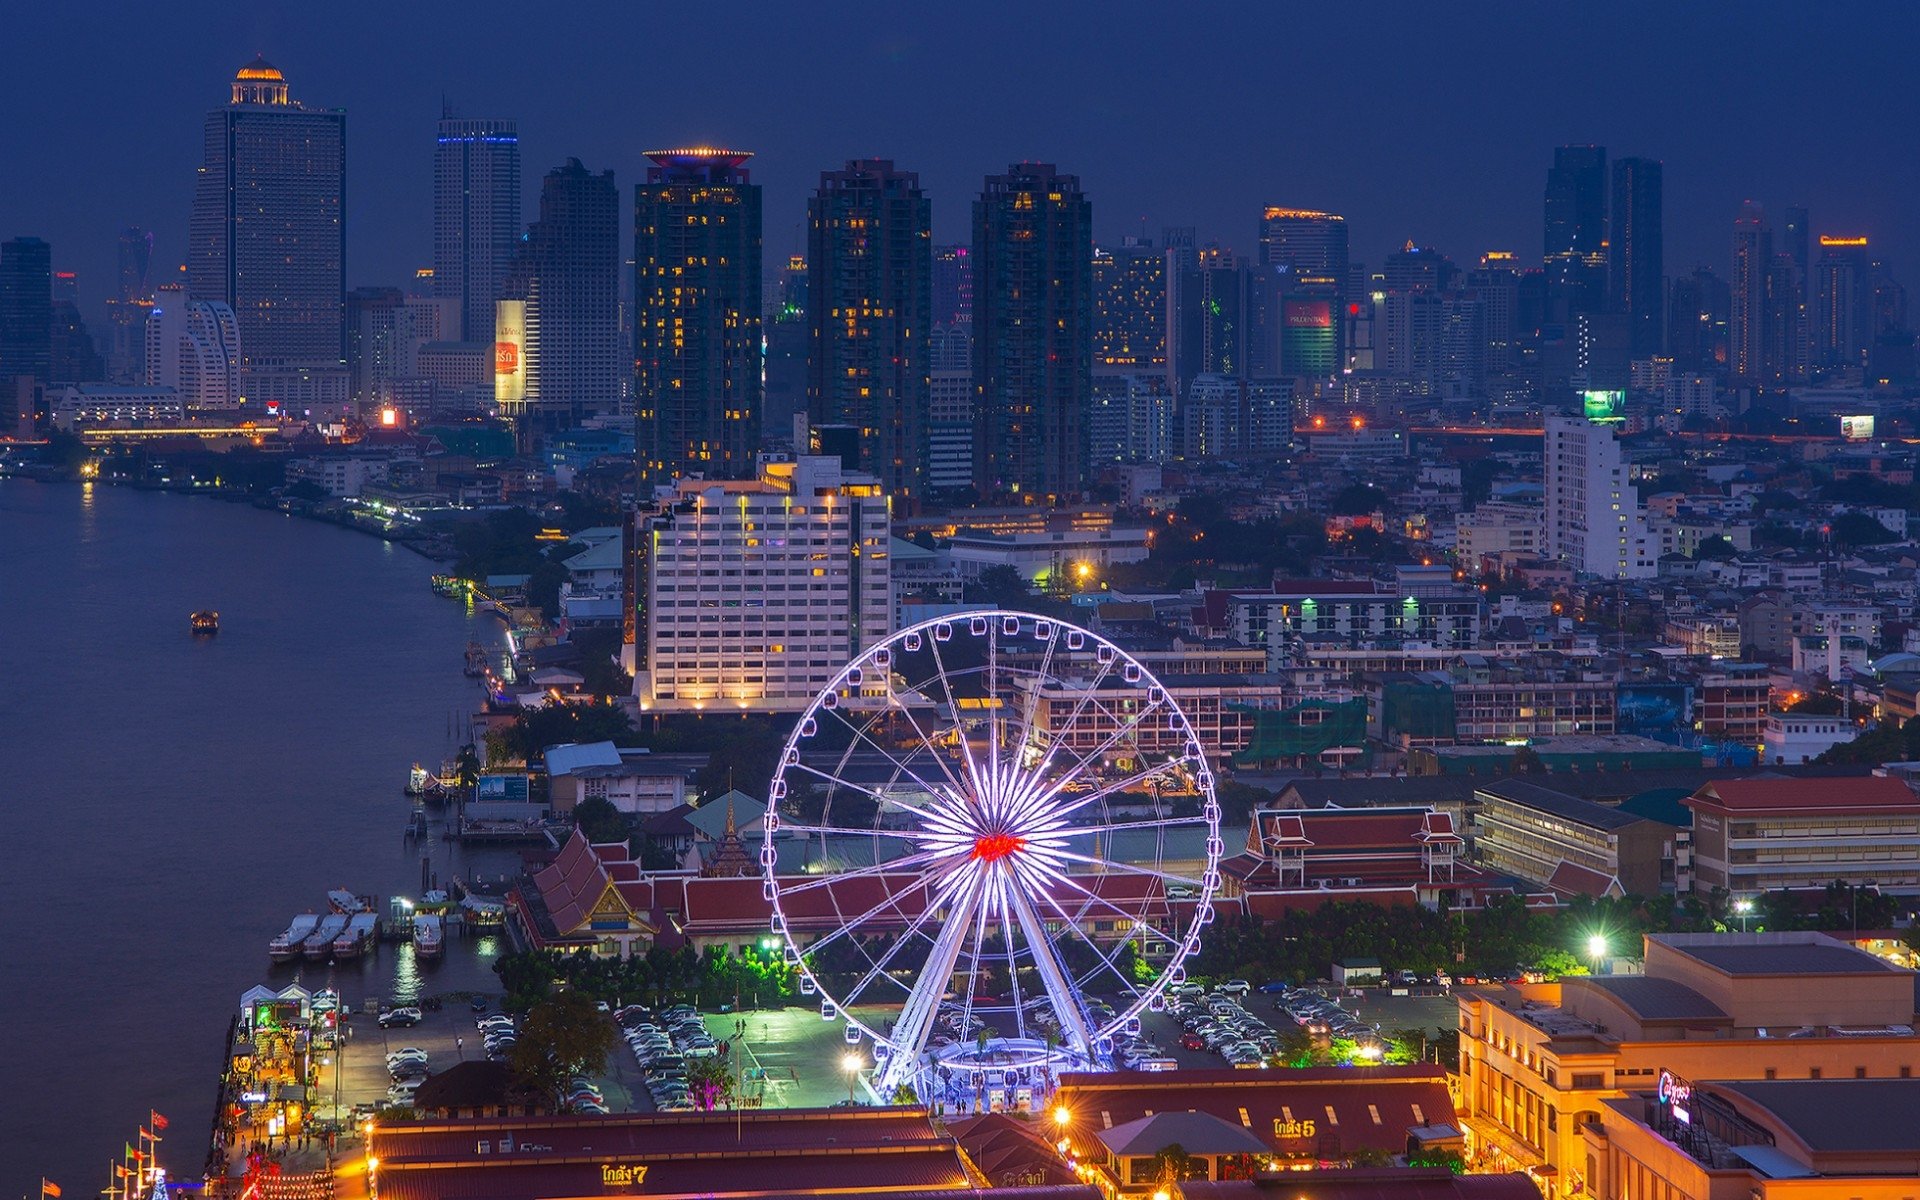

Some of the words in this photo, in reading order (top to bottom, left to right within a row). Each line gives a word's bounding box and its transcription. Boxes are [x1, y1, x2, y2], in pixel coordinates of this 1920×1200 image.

[242, 1093, 265, 1101] Chang
[1273, 1118, 1301, 1134] โกดัง
[1303, 1119, 1316, 1137] 5
[601, 1164, 631, 1181] โกดัง
[633, 1165, 648, 1184] 7
